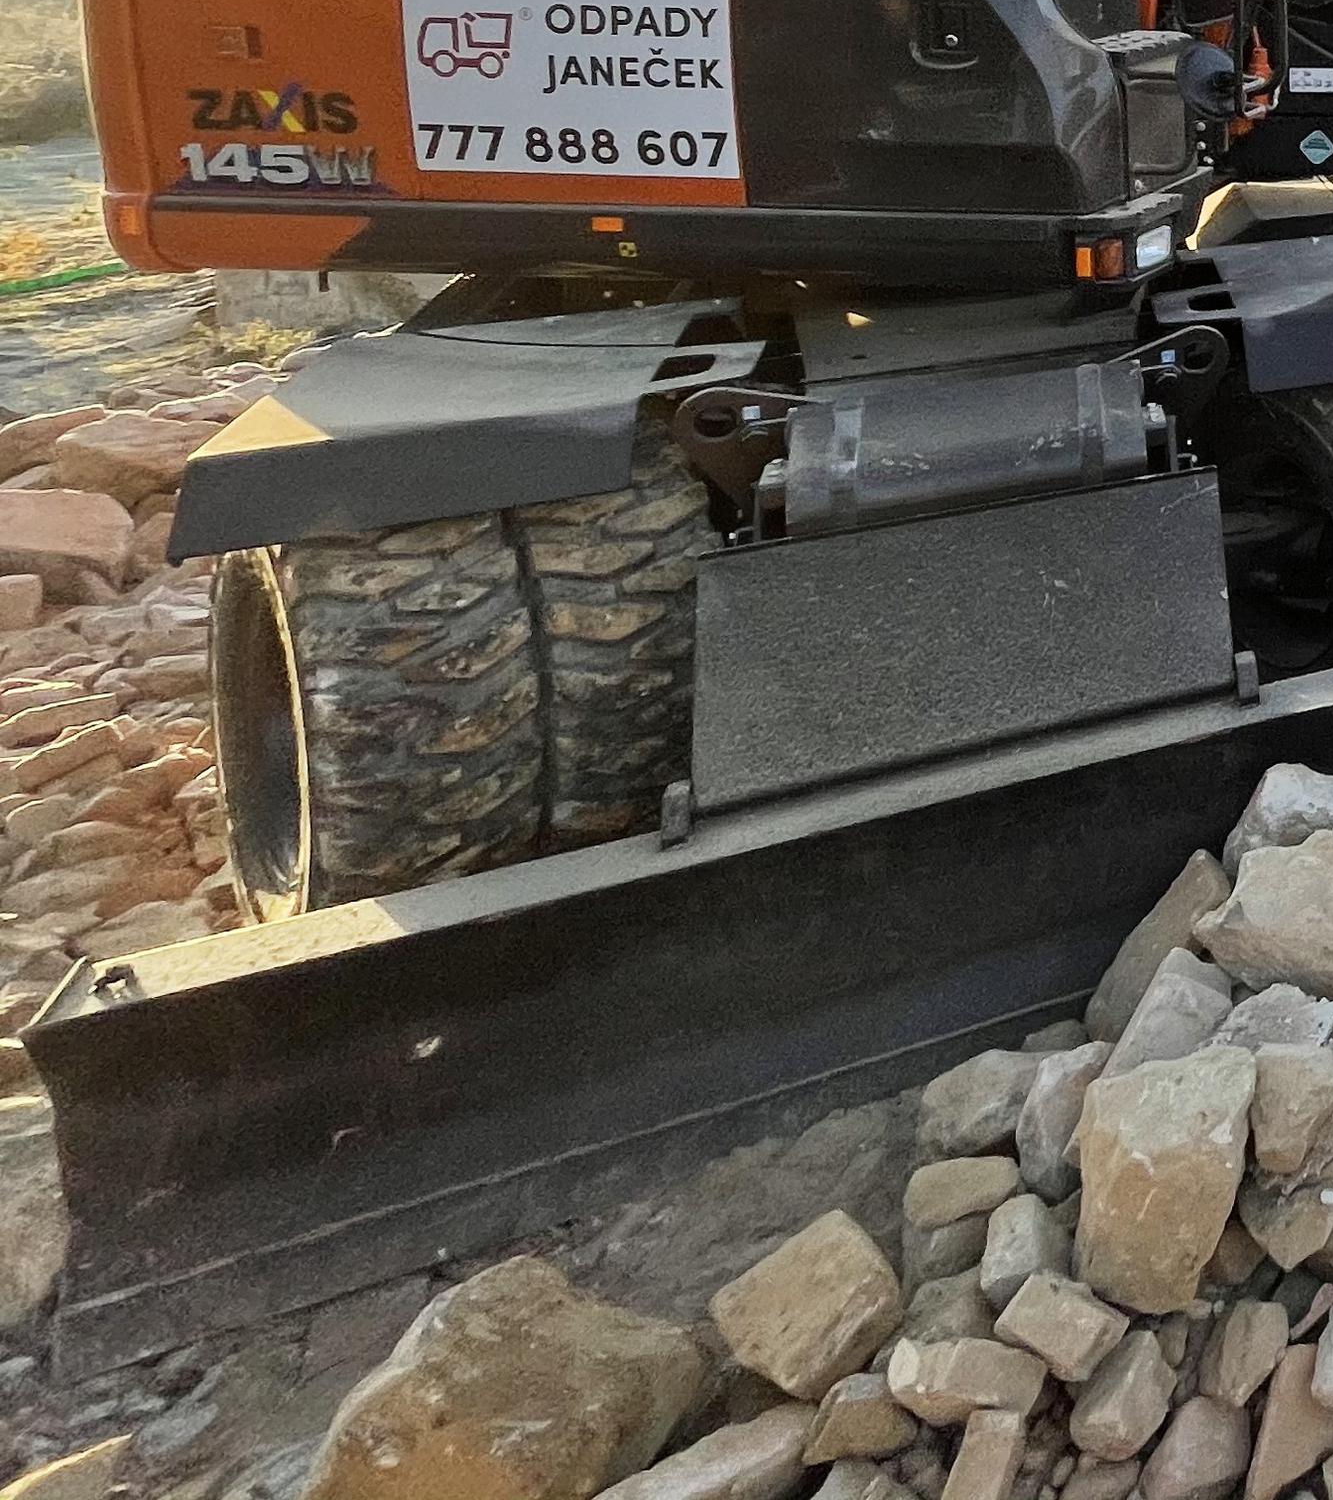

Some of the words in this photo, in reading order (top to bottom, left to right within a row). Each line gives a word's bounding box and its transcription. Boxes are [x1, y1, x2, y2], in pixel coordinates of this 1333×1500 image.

[545, 3, 718, 38] ODPADY
[543, 48, 724, 94] JANEČEK
[187, 83, 358, 134] ZAXIS
[180, 143, 374, 185] 145W
[418, 124, 505, 161] 777
[525, 127, 619, 164] 888
[637, 130, 728, 167] 607
